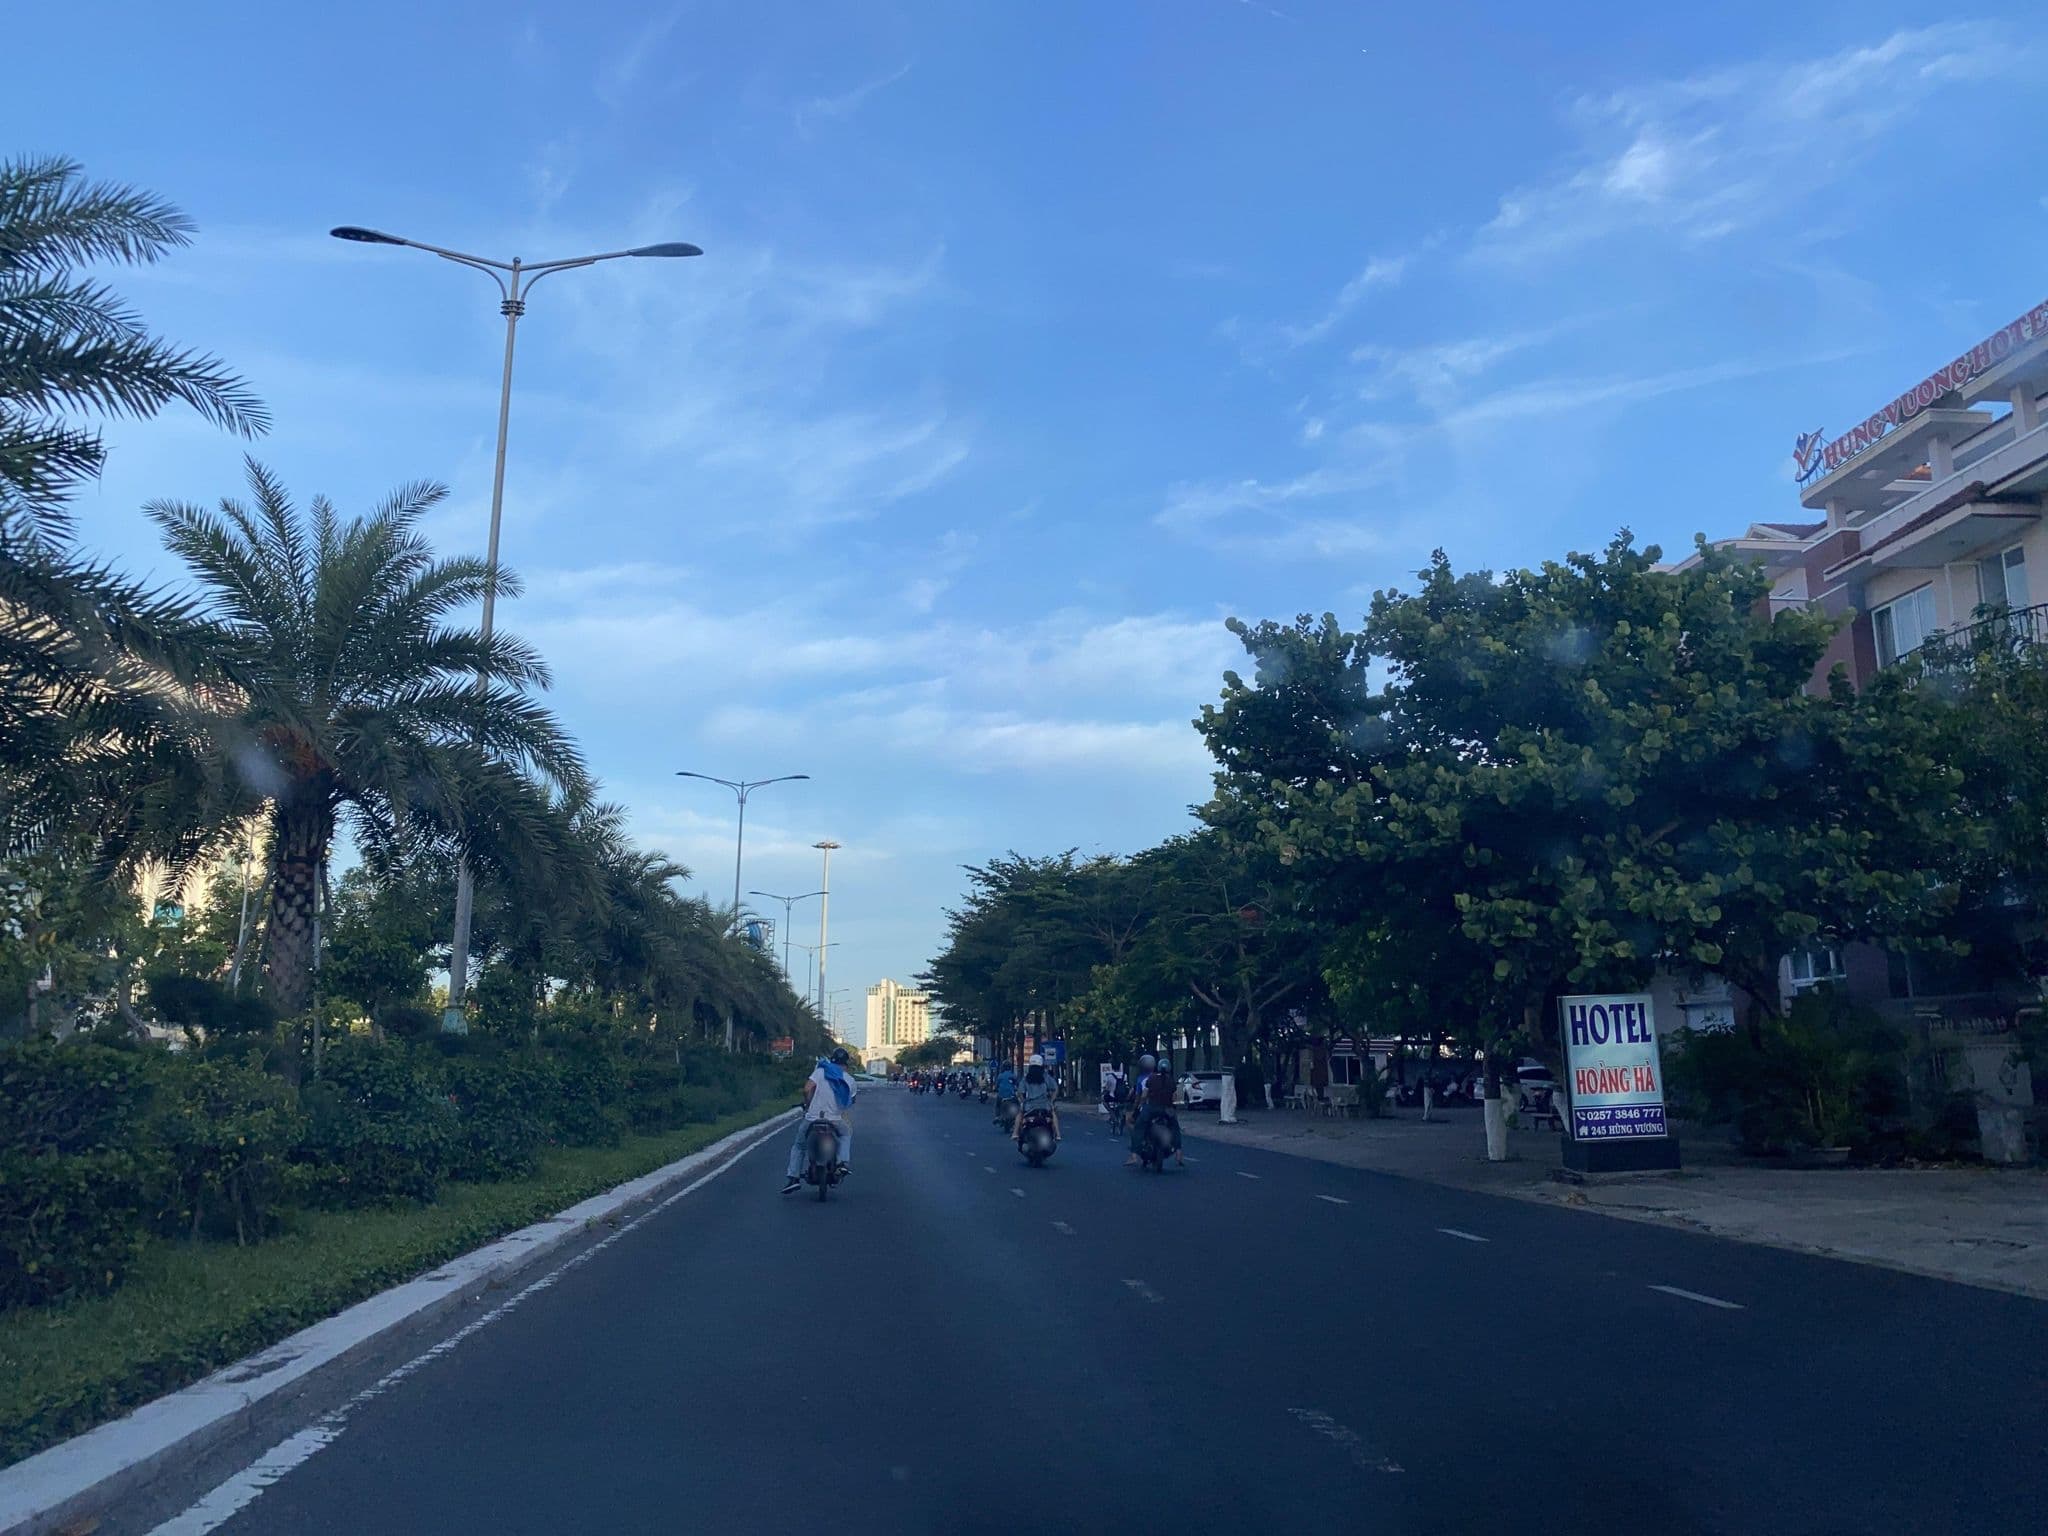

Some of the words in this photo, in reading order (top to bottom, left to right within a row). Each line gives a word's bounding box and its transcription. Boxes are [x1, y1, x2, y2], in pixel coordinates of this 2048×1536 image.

[1569, 1003, 1652, 1046] HOTEL
[1575, 1059, 1631, 1095] HOÀNG
[1633, 1058, 1657, 1093] HÀ
[1587, 1111, 1612, 1121] 0257
[1615, 1109, 1641, 1120] 3846
[1643, 1108, 1662, 1118] 777
[1591, 1125, 1607, 1136] 245
[1608, 1122, 1633, 1135] HÙNG
[1635, 1122, 1664, 1134] VƯƠNG
